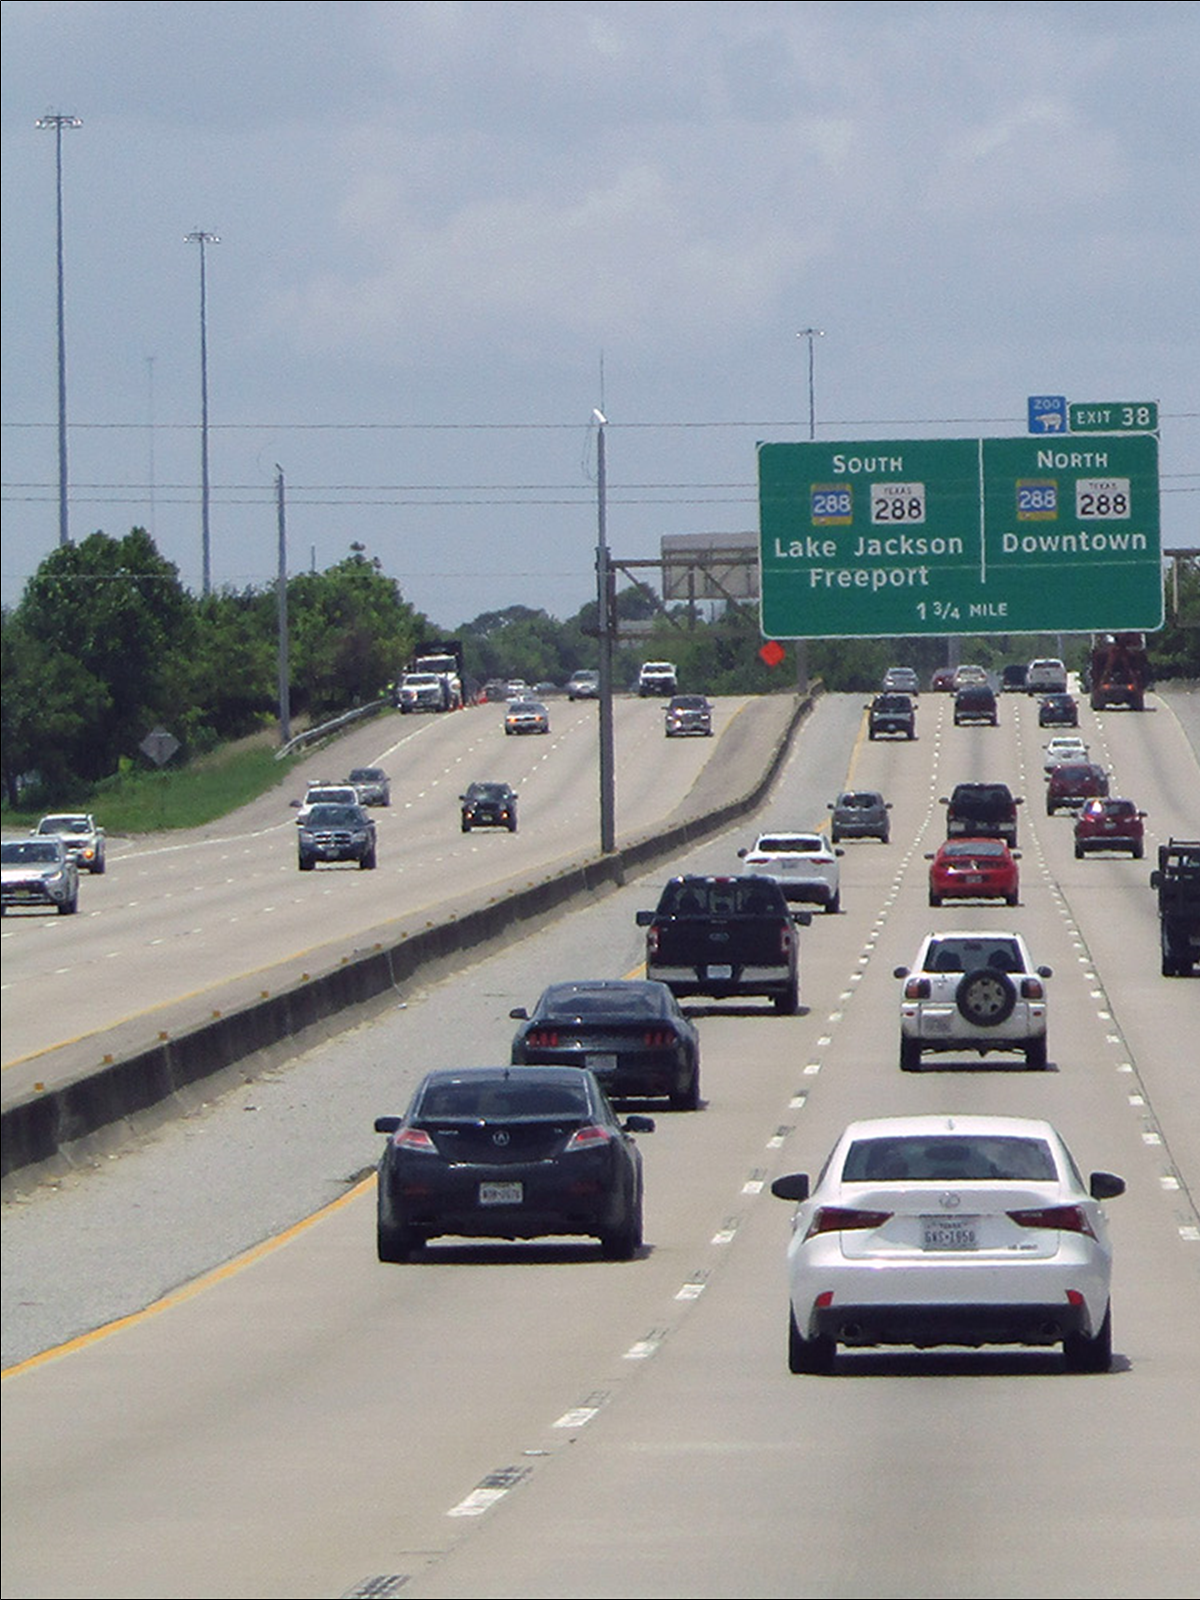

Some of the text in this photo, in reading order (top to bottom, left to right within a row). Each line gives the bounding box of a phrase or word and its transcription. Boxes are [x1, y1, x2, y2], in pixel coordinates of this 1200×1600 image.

[1034, 399, 1060, 410] ZOO
[1077, 407, 1150, 426] EXIT 38
[833, 455, 903, 473] SOUTH
[1037, 450, 1108, 469] NORTH
[884, 487, 912, 496] TEXAS
[1089, 482, 1117, 490] TEXAS
[814, 494, 851, 514] 288
[875, 498, 922, 520] 288
[1020, 490, 1056, 509] 288
[1080, 494, 1127, 516] 288
[775, 535, 963, 558] Lake Jackson
[1003, 531, 1147, 553] Downtown
[810, 565, 929, 592] Freeport
[969, 602, 1008, 617] MILE
